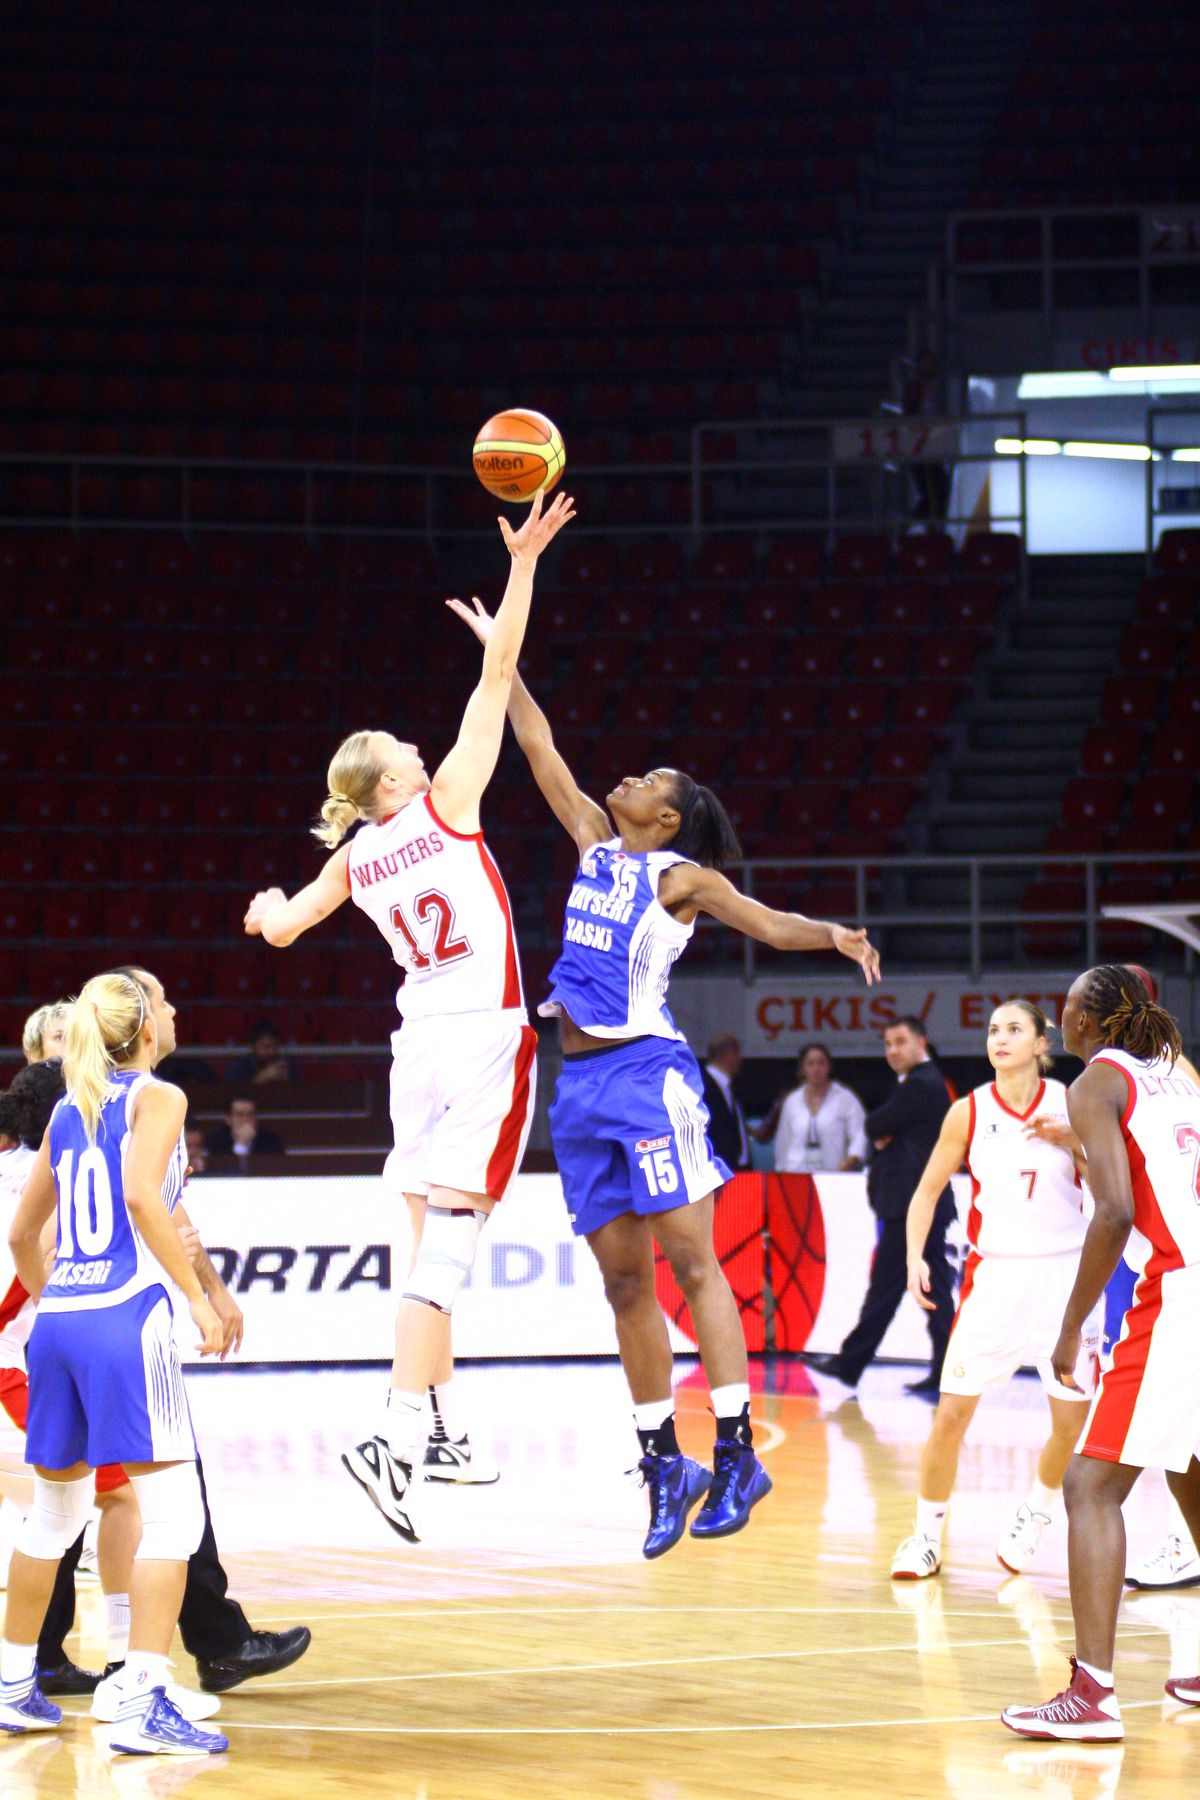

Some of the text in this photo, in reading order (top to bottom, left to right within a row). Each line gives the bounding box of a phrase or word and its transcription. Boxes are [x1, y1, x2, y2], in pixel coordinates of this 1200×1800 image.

[859, 426, 932, 457] 117
[352, 832, 444, 889] WAUTERS
[610, 863, 641, 901] 15
[390, 888, 474, 972] 12
[959, 991, 1067, 1029] ET
[639, 1150, 678, 1196] 15
[1019, 1169, 1038, 1202] 7
[56, 1147, 113, 1258] 10
